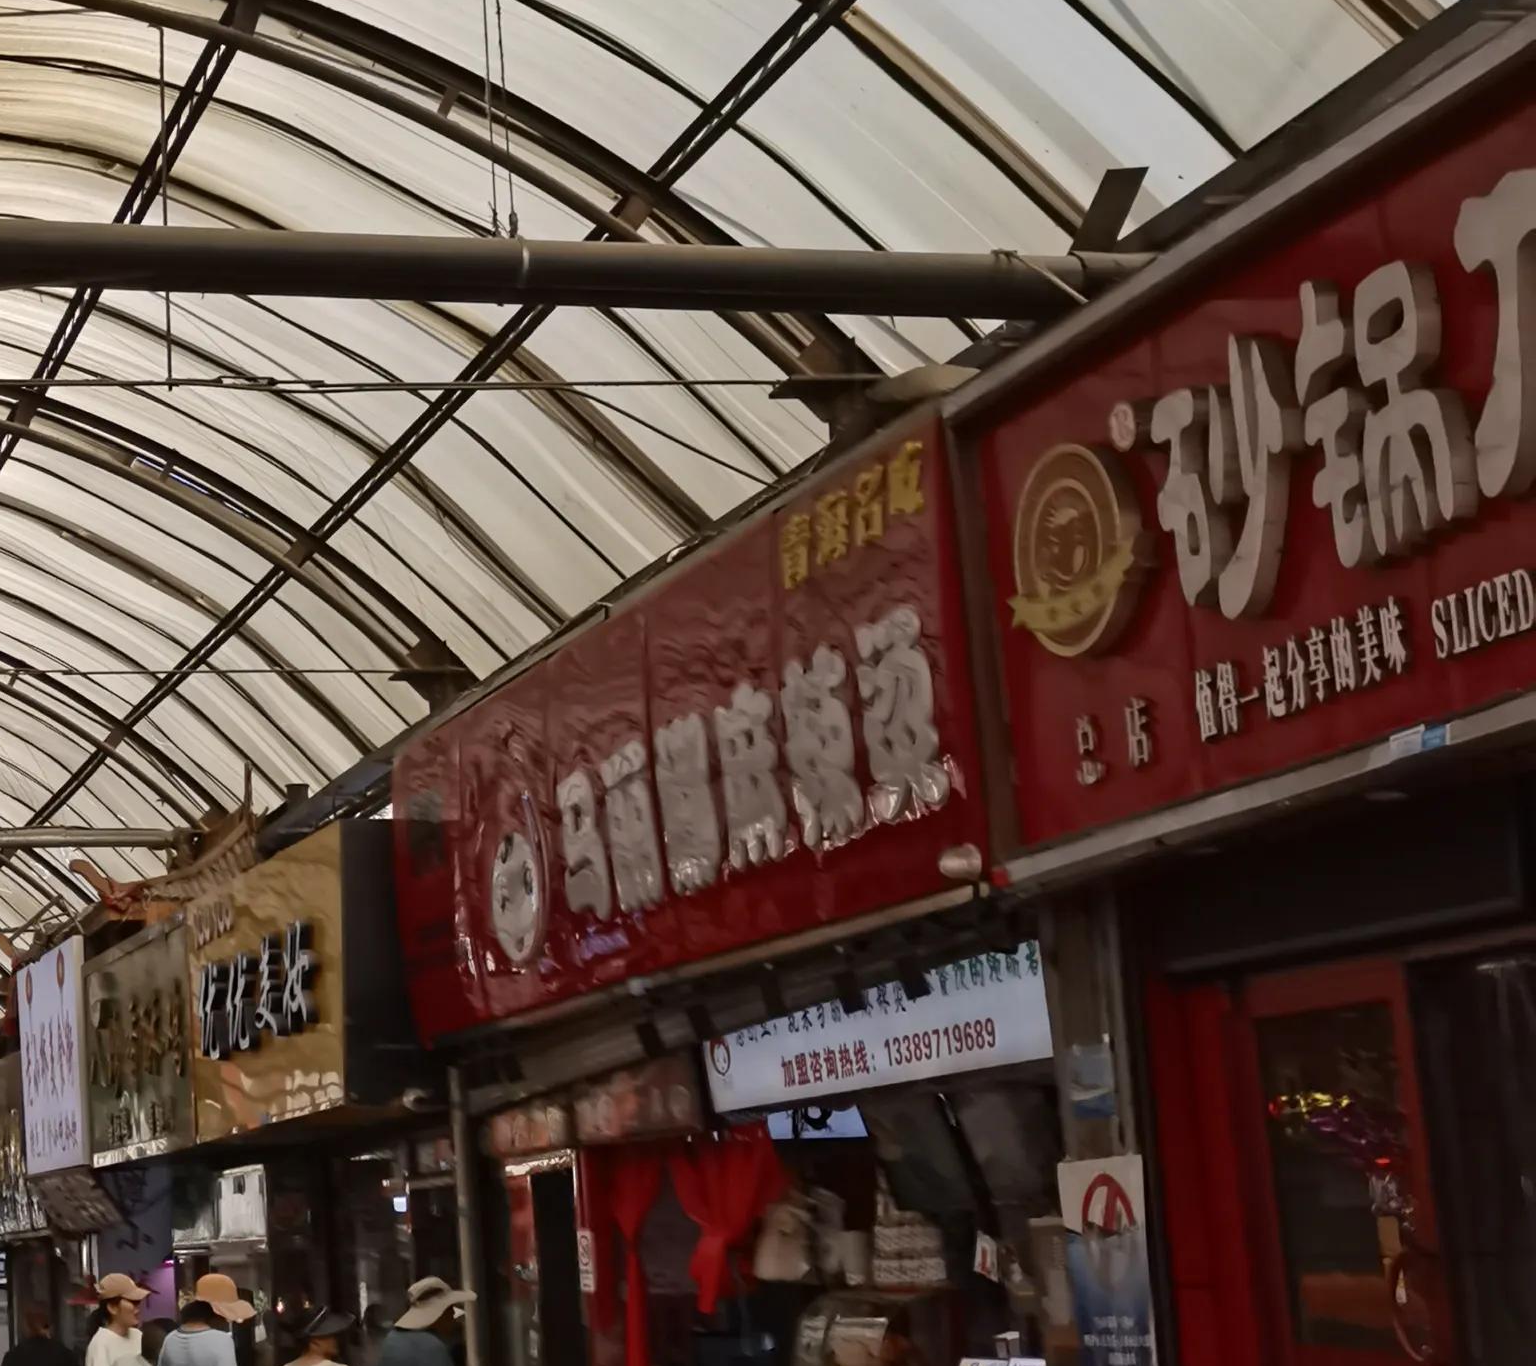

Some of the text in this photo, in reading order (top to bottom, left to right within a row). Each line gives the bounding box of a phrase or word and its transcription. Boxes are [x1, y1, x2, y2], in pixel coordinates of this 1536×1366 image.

[1194, 595, 1407, 743] 值得一起分享的美味
[1431, 568, 1535, 660] SLICED
